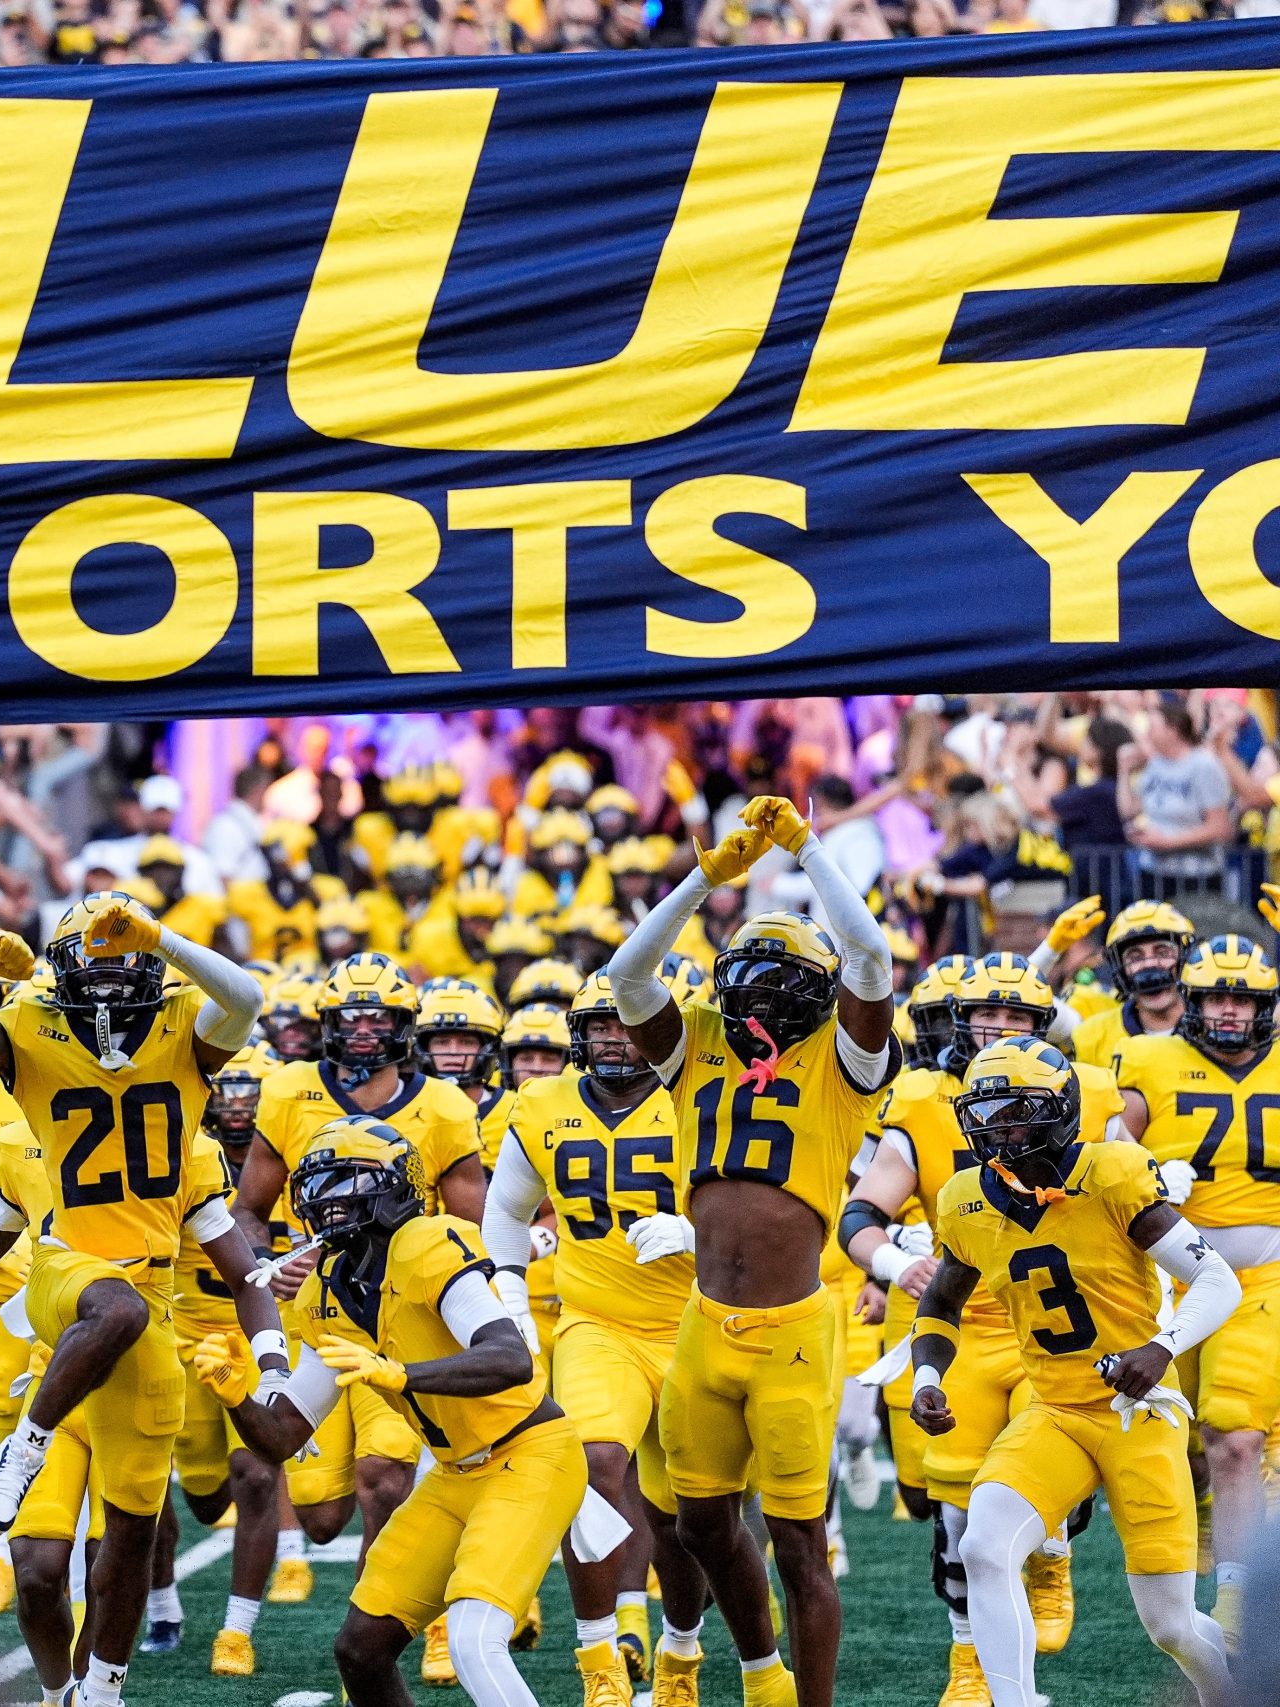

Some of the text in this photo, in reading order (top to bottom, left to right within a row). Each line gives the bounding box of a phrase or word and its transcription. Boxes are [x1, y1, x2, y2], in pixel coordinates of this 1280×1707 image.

[99, 1017, 109, 1051] BATTLE
[50, 1081, 183, 1209] 20
[544, 1131, 554, 1150] C
[689, 1076, 801, 1187] 16
[554, 1135, 676, 1241] 95
[1147, 1158, 1170, 1197] 3
[446, 1228, 477, 1262] 1
[1184, 1235, 1215, 1261] M
[1008, 1243, 1098, 1355] 3
[27, 1430, 48, 1447] M
[107, 1670, 126, 1684] M
